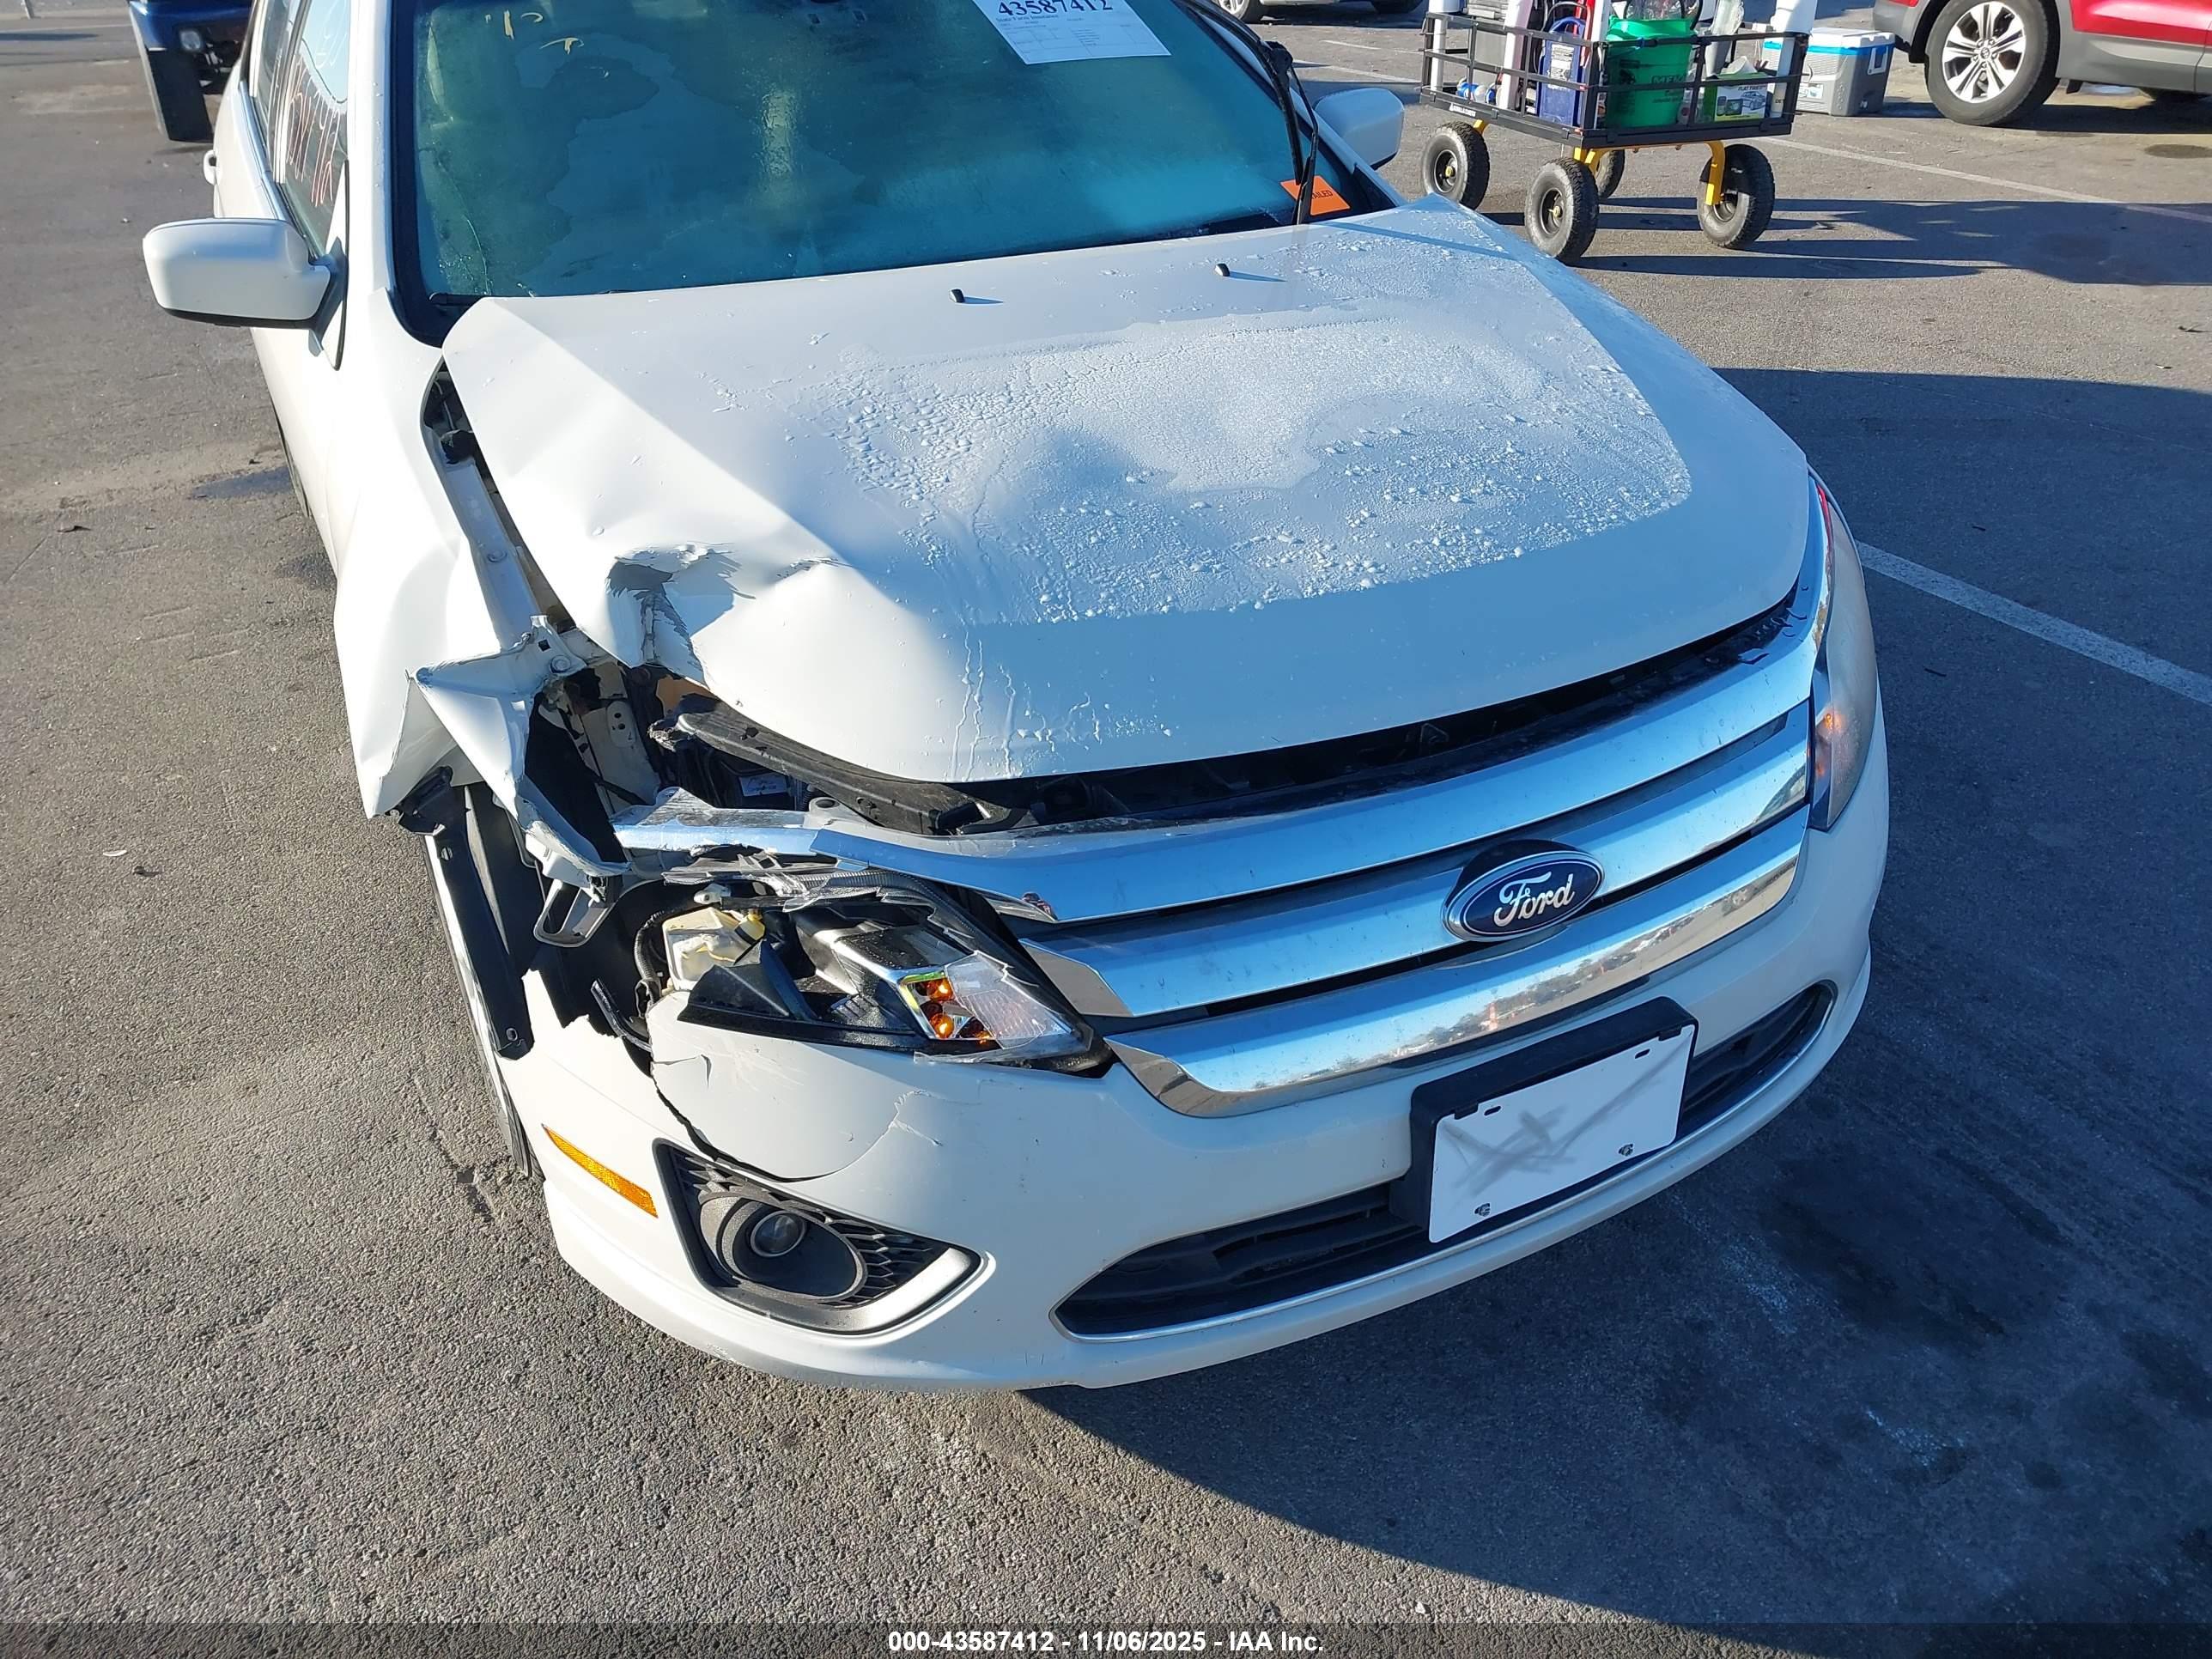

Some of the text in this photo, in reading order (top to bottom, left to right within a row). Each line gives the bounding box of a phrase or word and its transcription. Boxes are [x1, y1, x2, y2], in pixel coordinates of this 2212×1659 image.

[999, 0, 1113, 15] 43587412
[1312, 190, 1333, 198] AILED
[1493, 872, 1575, 927] Ford
